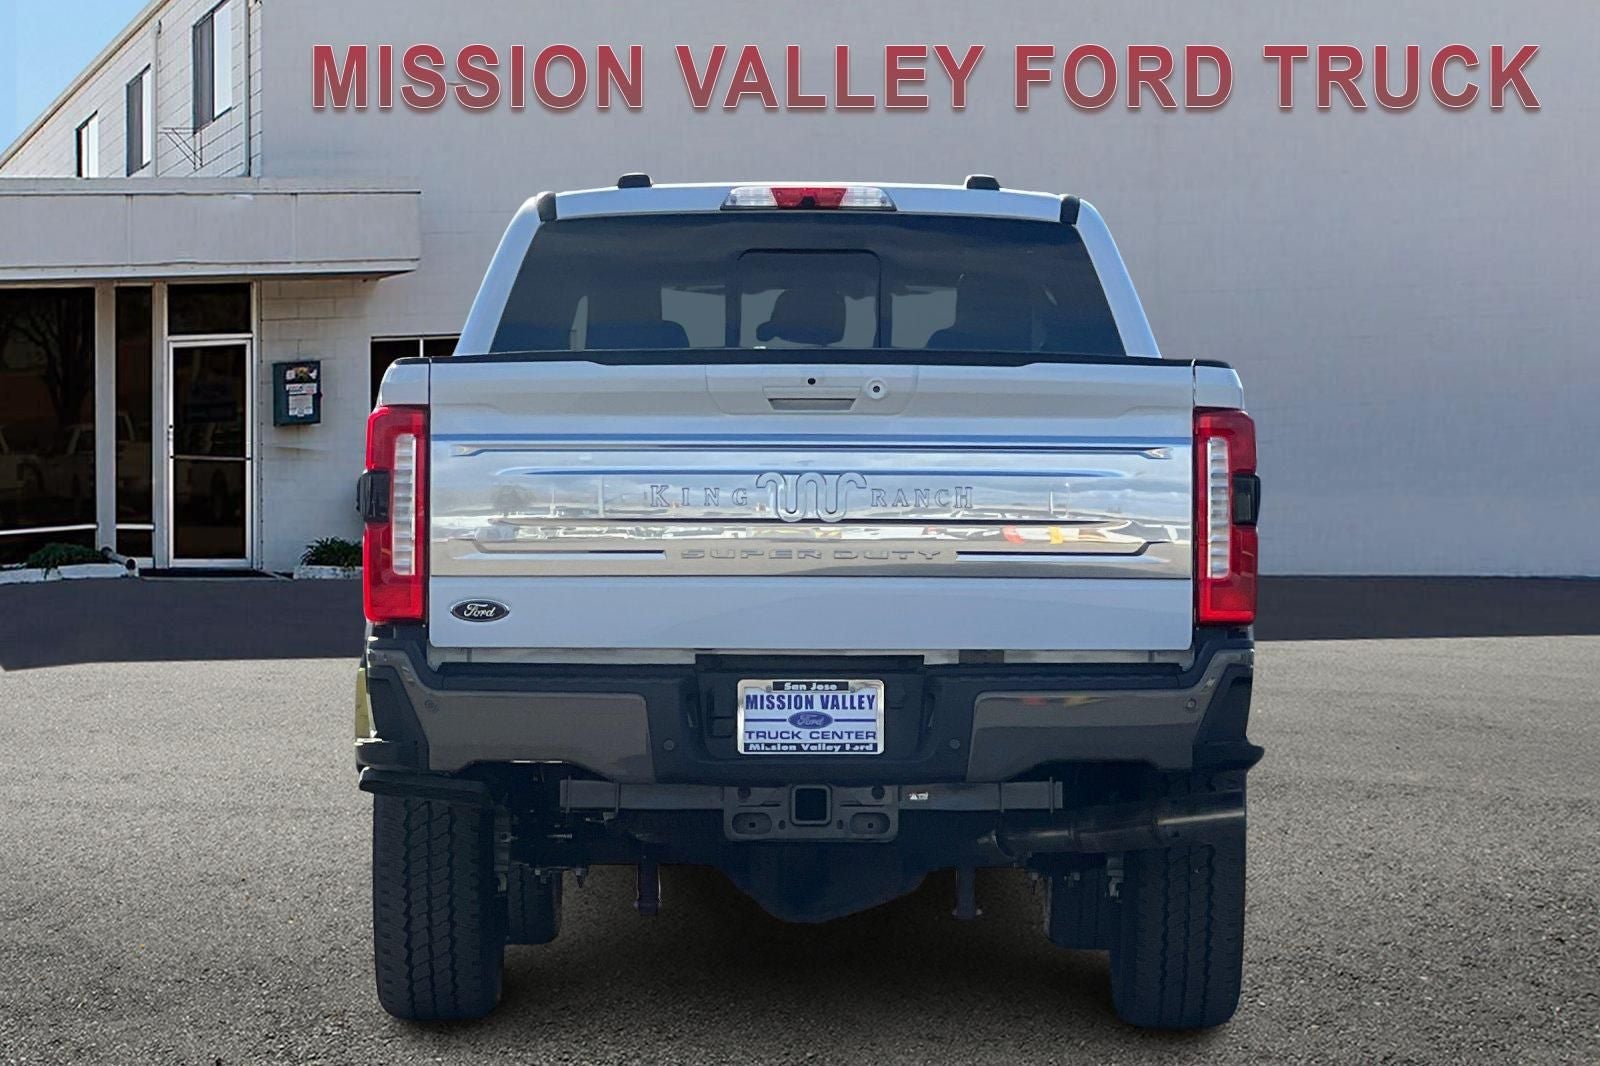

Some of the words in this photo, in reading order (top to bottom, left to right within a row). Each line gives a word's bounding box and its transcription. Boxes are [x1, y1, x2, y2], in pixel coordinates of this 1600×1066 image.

[649, 484, 748, 507] KING
[871, 485, 974, 509] RANCH
[681, 549, 822, 560] SUPER
[834, 549, 941, 560] DUTY
[463, 603, 496, 617] Ford
[784, 682, 807, 691] San
[811, 682, 838, 691] Jose
[745, 694, 814, 710] MISSION
[820, 694, 876, 710] VALLEY
[797, 714, 824, 726] Ford
[745, 730, 802, 740] TRUCK
[809, 730, 876, 740] CENTER
[801, 743, 841, 752] Valley
